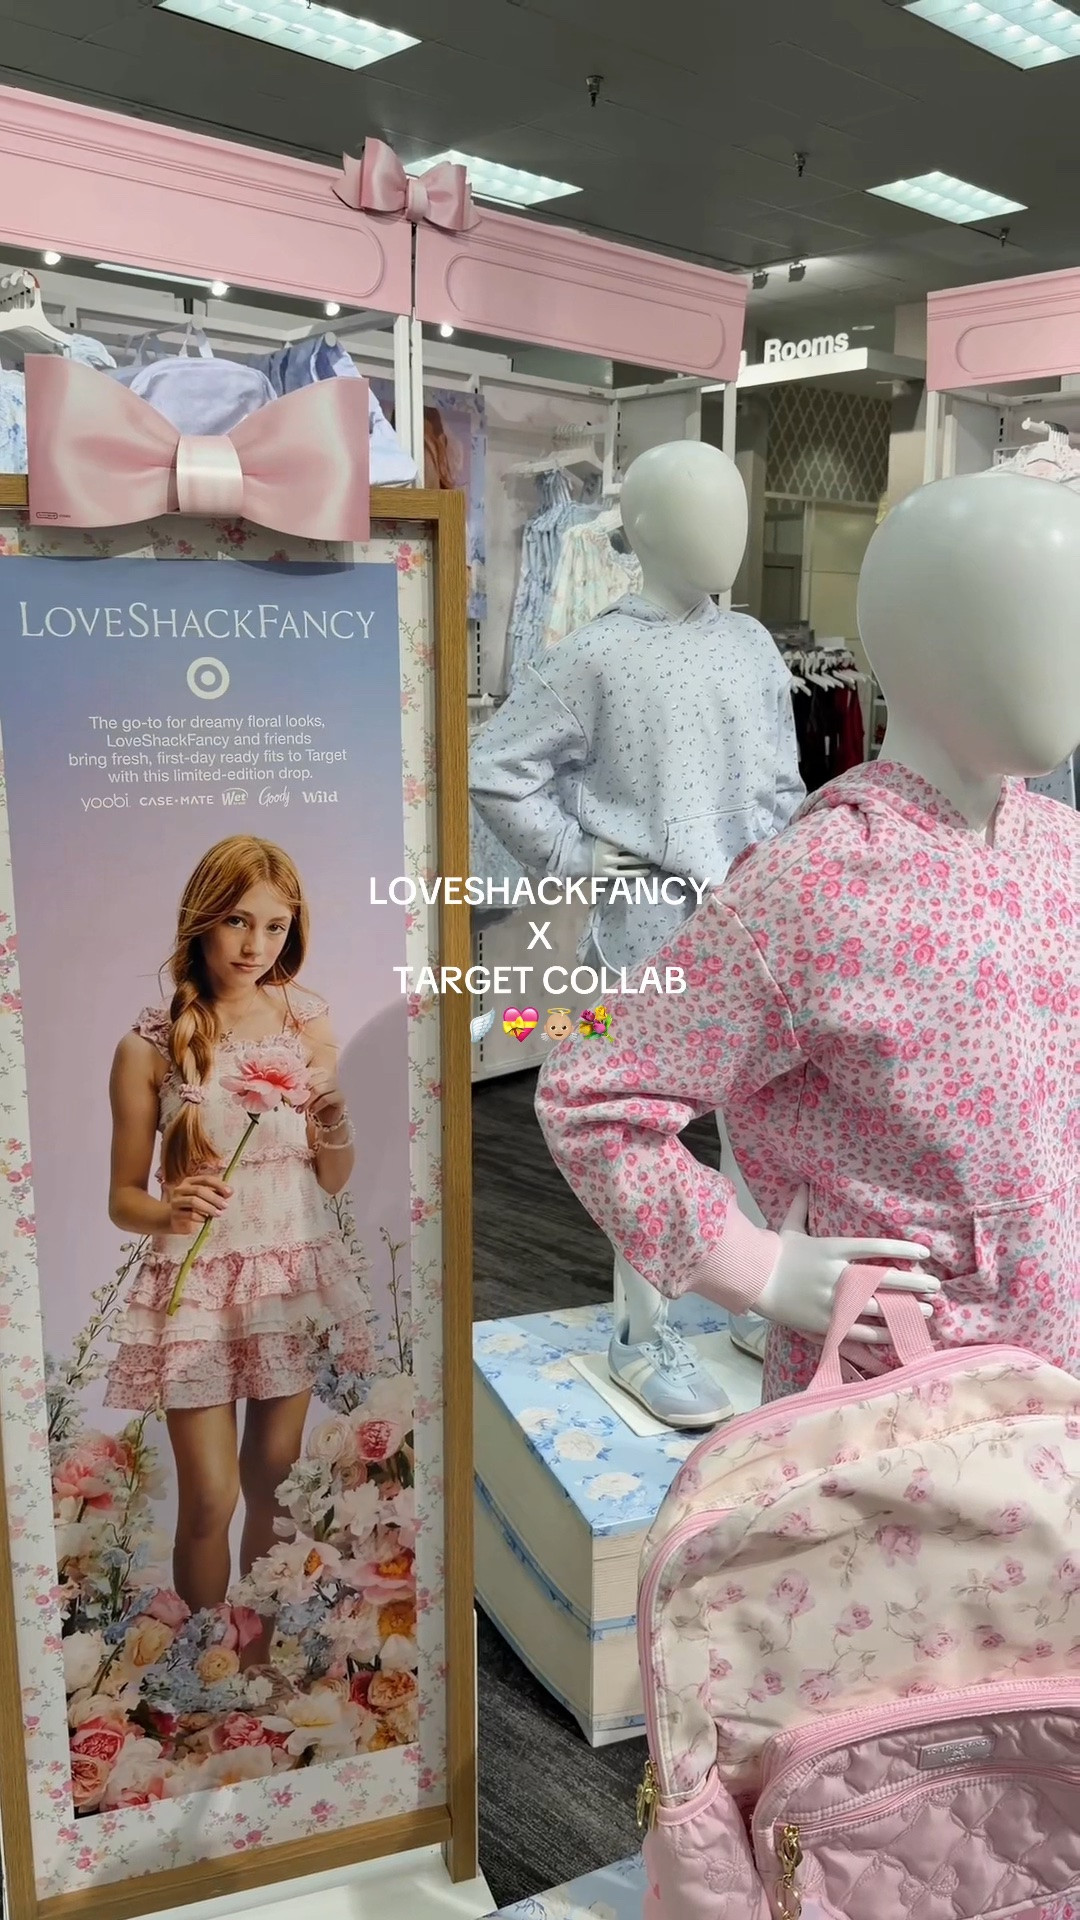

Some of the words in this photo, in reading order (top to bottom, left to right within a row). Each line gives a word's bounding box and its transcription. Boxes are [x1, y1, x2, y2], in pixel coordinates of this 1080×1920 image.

[764, 332, 849, 364] Rooms
[20, 601, 375, 639] LOVESHACKFANCY
[89, 716, 118, 729] The
[122, 717, 163, 731] go-to
[167, 716, 186, 729] for
[190, 716, 243, 731] dreamy
[247, 715, 282, 728] floral
[285, 715, 325, 729] looks,
[106, 734, 230, 749] LoveShackFancy
[234, 734, 260, 745] and
[264, 733, 312, 744] friends
[68, 753, 107, 769] bring
[112, 752, 153, 766] fresh,
[157, 752, 215, 766] first-day
[220, 750, 260, 765] ready
[263, 750, 284, 762] fits
[288, 750, 302, 761] to
[306, 749, 347, 764] Target
[108, 770, 139, 783] with
[143, 770, 170, 782] this
[173, 768, 275, 781] limited-edition
[278, 767, 313, 782] drop.
[81, 793, 129, 812] yoobi
[222, 791, 246, 805] Wet
[258, 786, 290, 808] Goody
[302, 790, 338, 803] Wild
